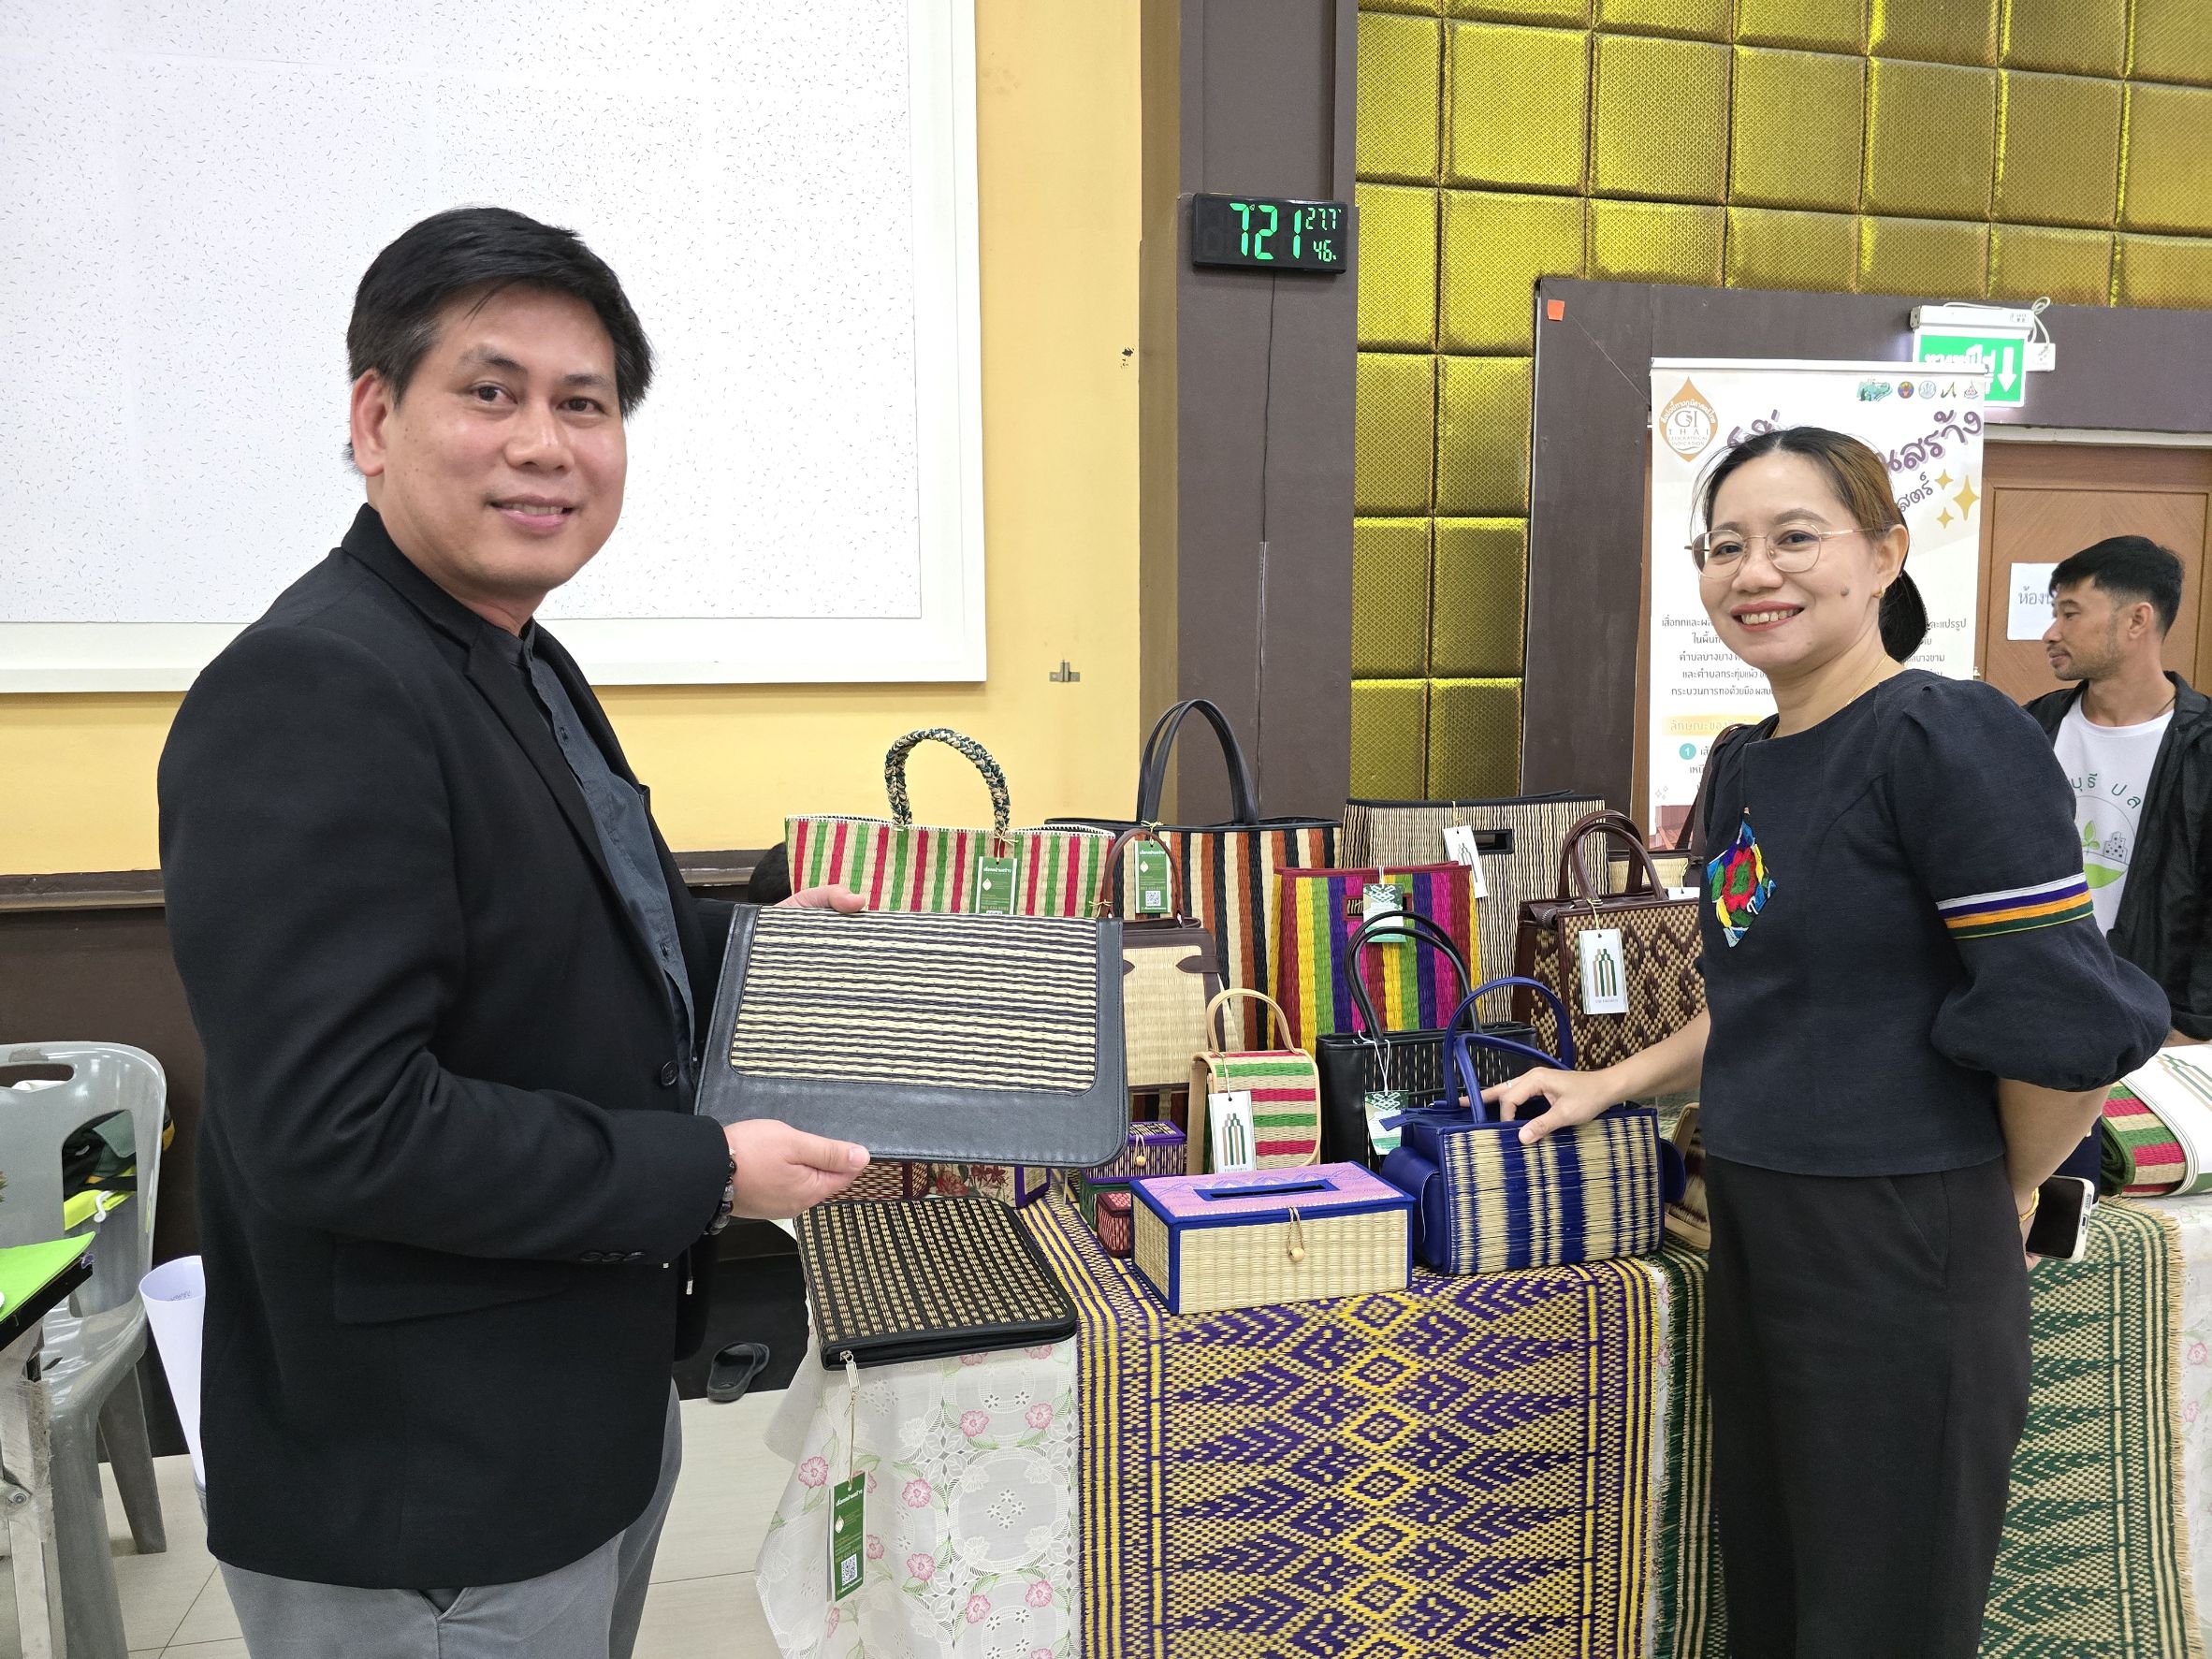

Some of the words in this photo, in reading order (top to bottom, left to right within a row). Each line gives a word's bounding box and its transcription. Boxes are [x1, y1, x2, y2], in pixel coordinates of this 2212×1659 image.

[1674, 410, 1698, 428] GI
[1668, 428, 1709, 436] THAI
[1897, 471, 1934, 513] สตร์
[1929, 618, 1967, 632] ละแปรรูป
[2071, 773, 2098, 792] บุรี
[2111, 783, 2142, 809] ปล
